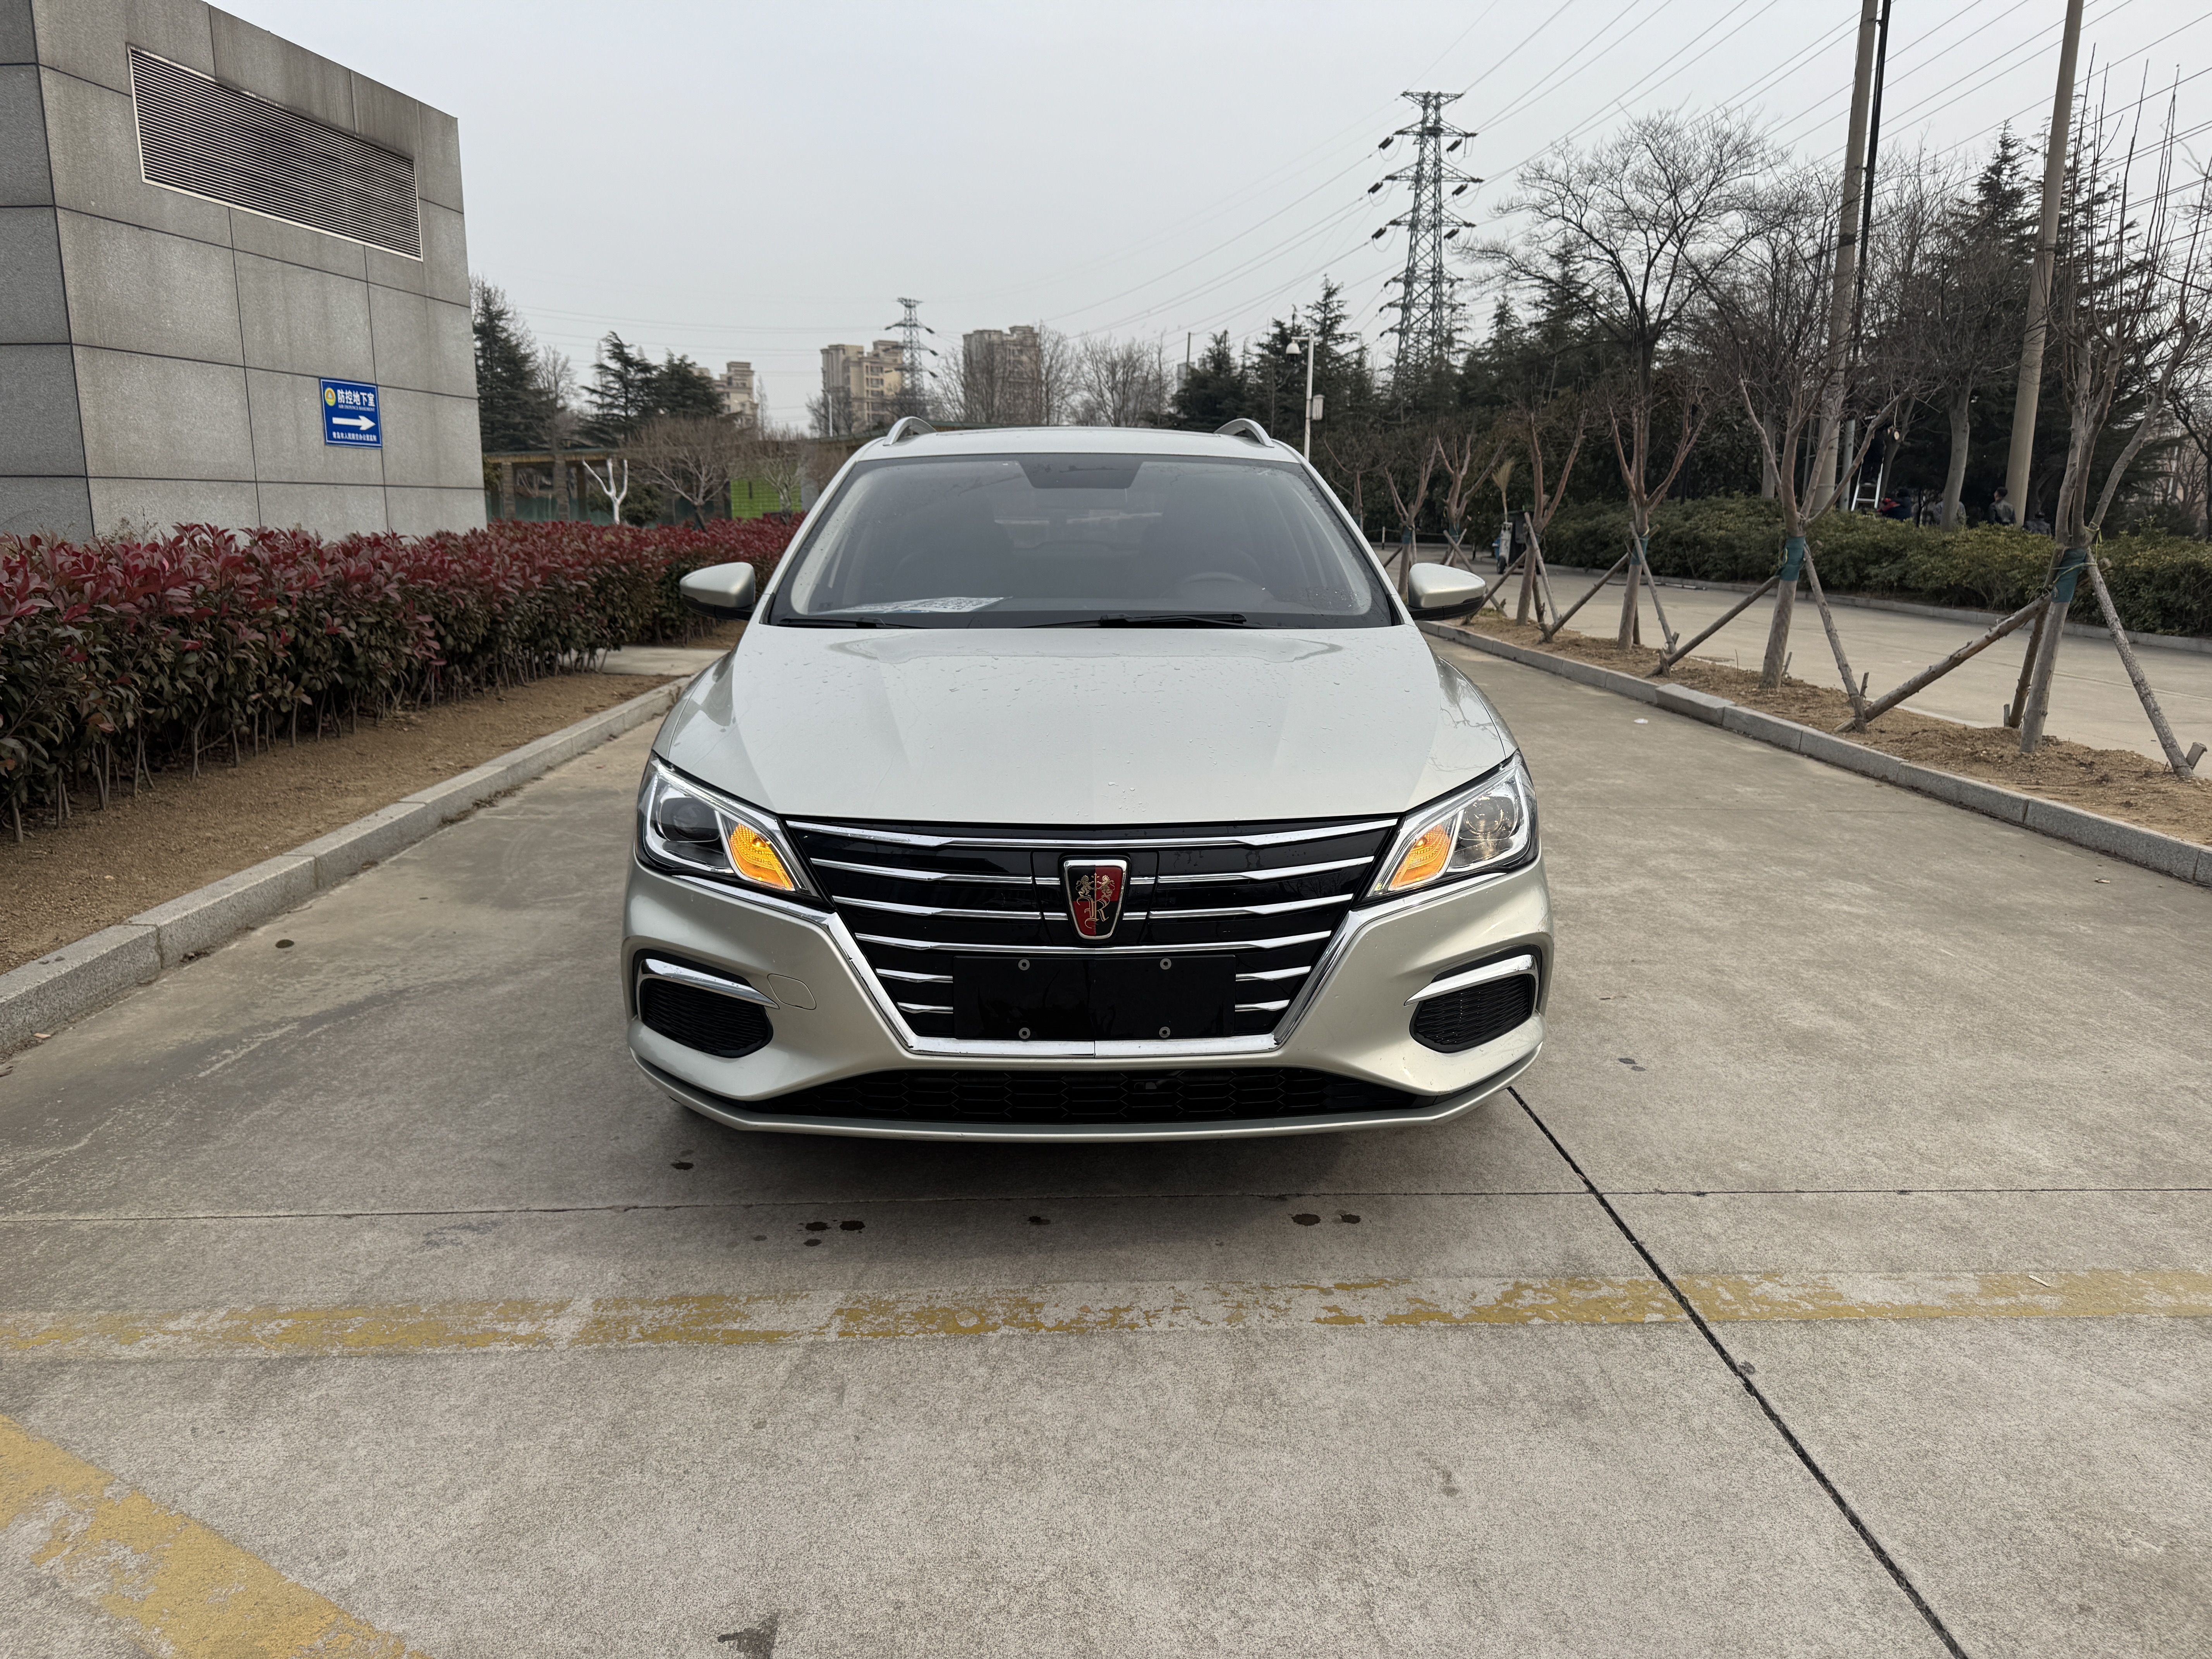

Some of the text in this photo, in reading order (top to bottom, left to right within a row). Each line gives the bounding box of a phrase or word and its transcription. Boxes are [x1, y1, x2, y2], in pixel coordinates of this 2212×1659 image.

[337, 388, 375, 407] 防控地下室
